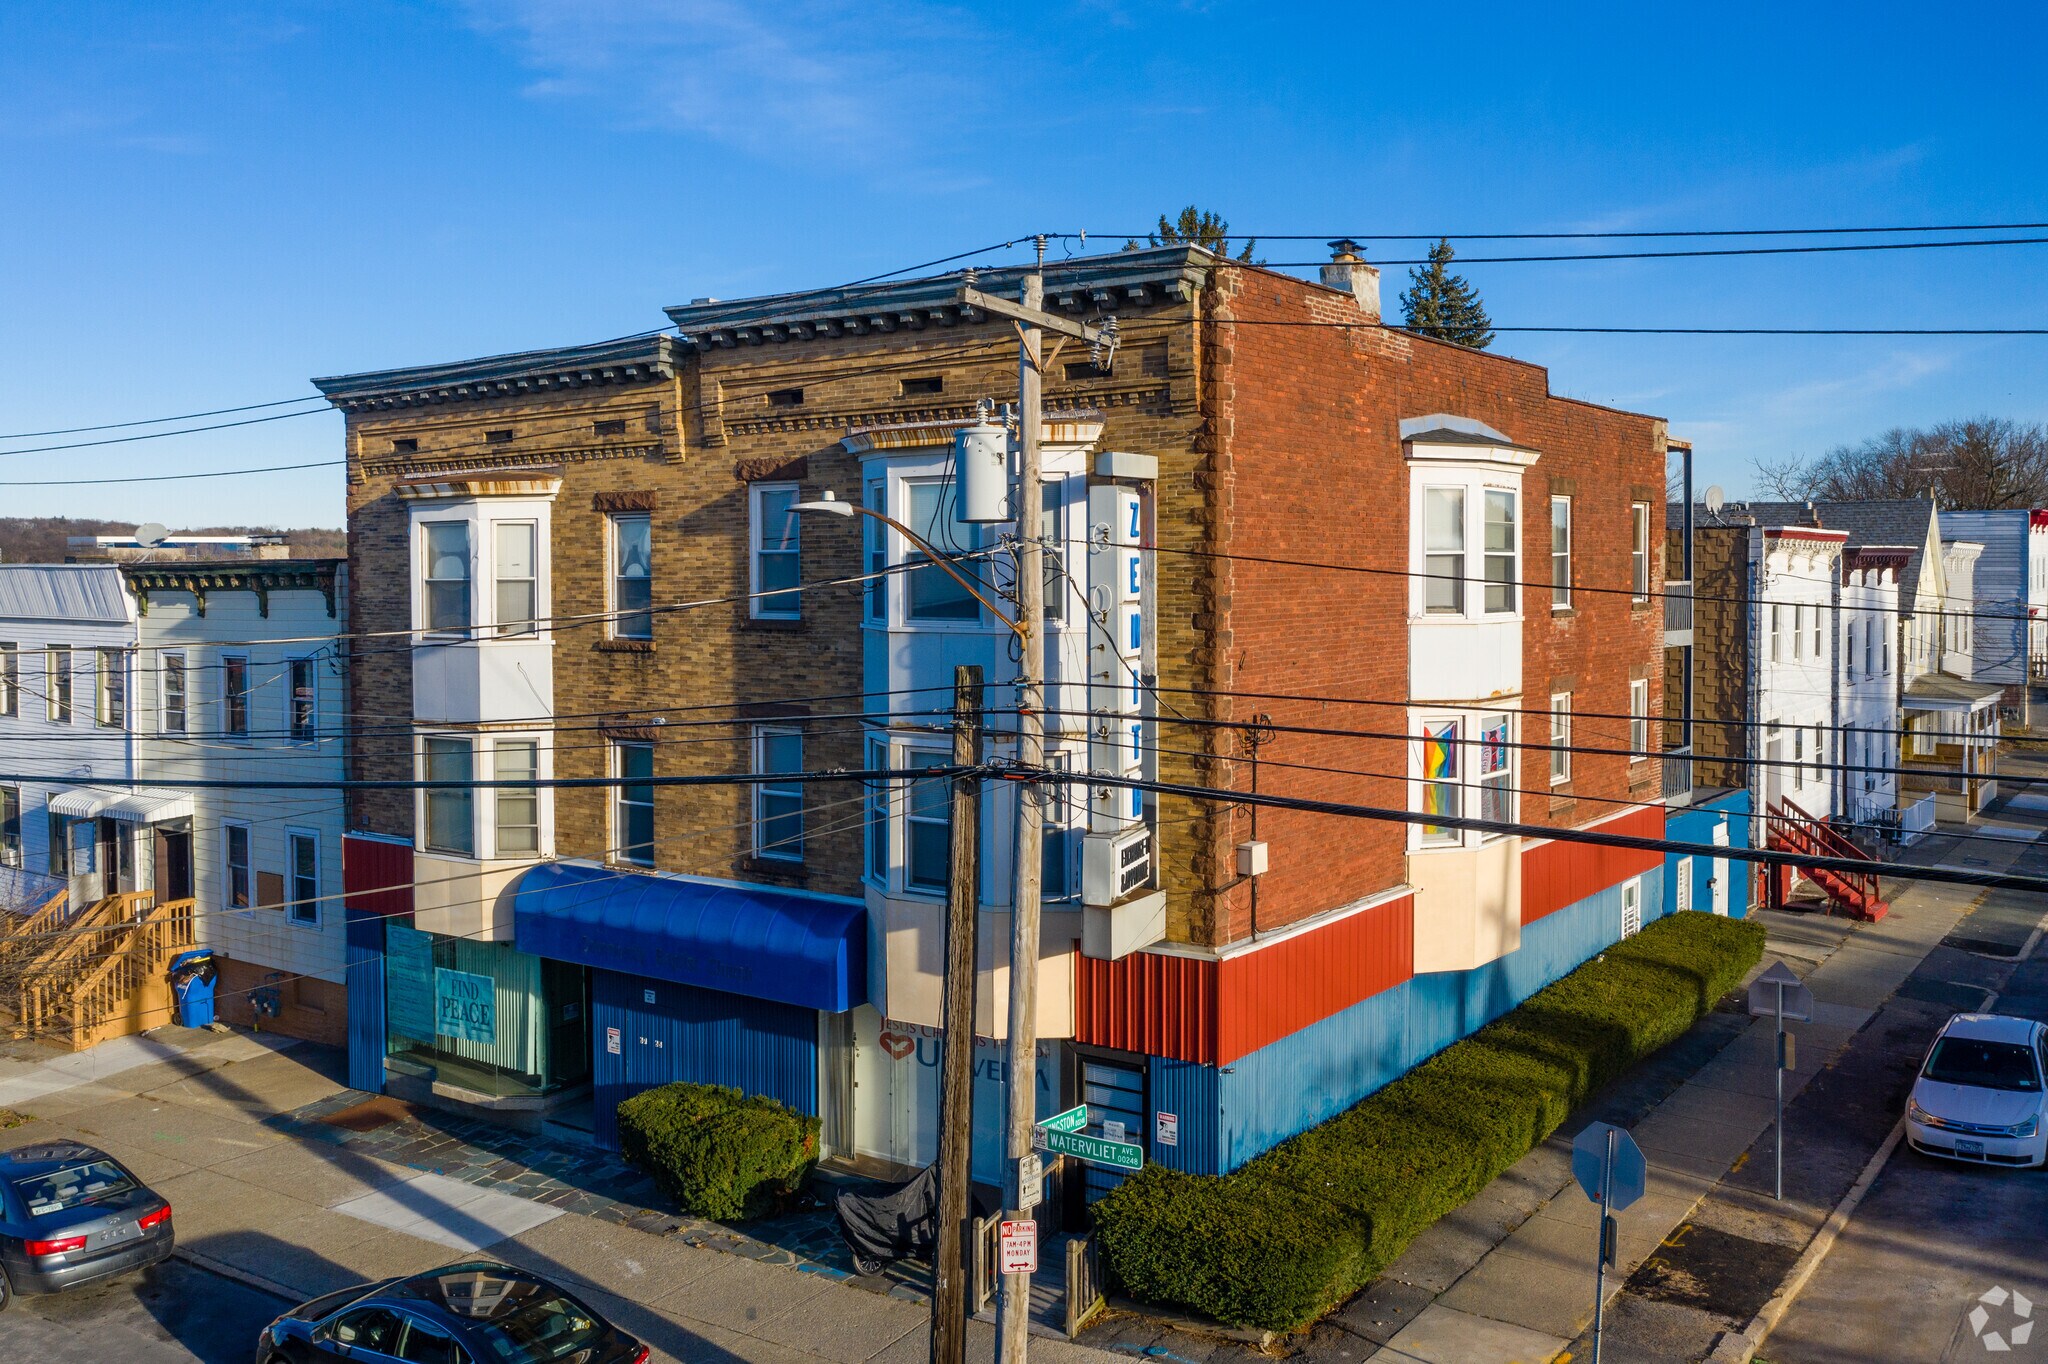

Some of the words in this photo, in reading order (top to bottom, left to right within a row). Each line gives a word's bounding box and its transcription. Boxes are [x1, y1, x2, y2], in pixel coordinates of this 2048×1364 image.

[451, 980, 479, 1000] FIND
[442, 996, 490, 1026] PEACE
[1050, 1133, 1116, 1160] WATERVLIET
[1121, 1147, 1134, 1156] AVE
[1117, 1155, 1139, 1166] 00248
[1002, 1225, 1012, 1236] NO
[1012, 1225, 1034, 1233] PARKING
[1006, 1240, 1032, 1248] 7AM-4PM
[1006, 1249, 1031, 1257] MONDAY
